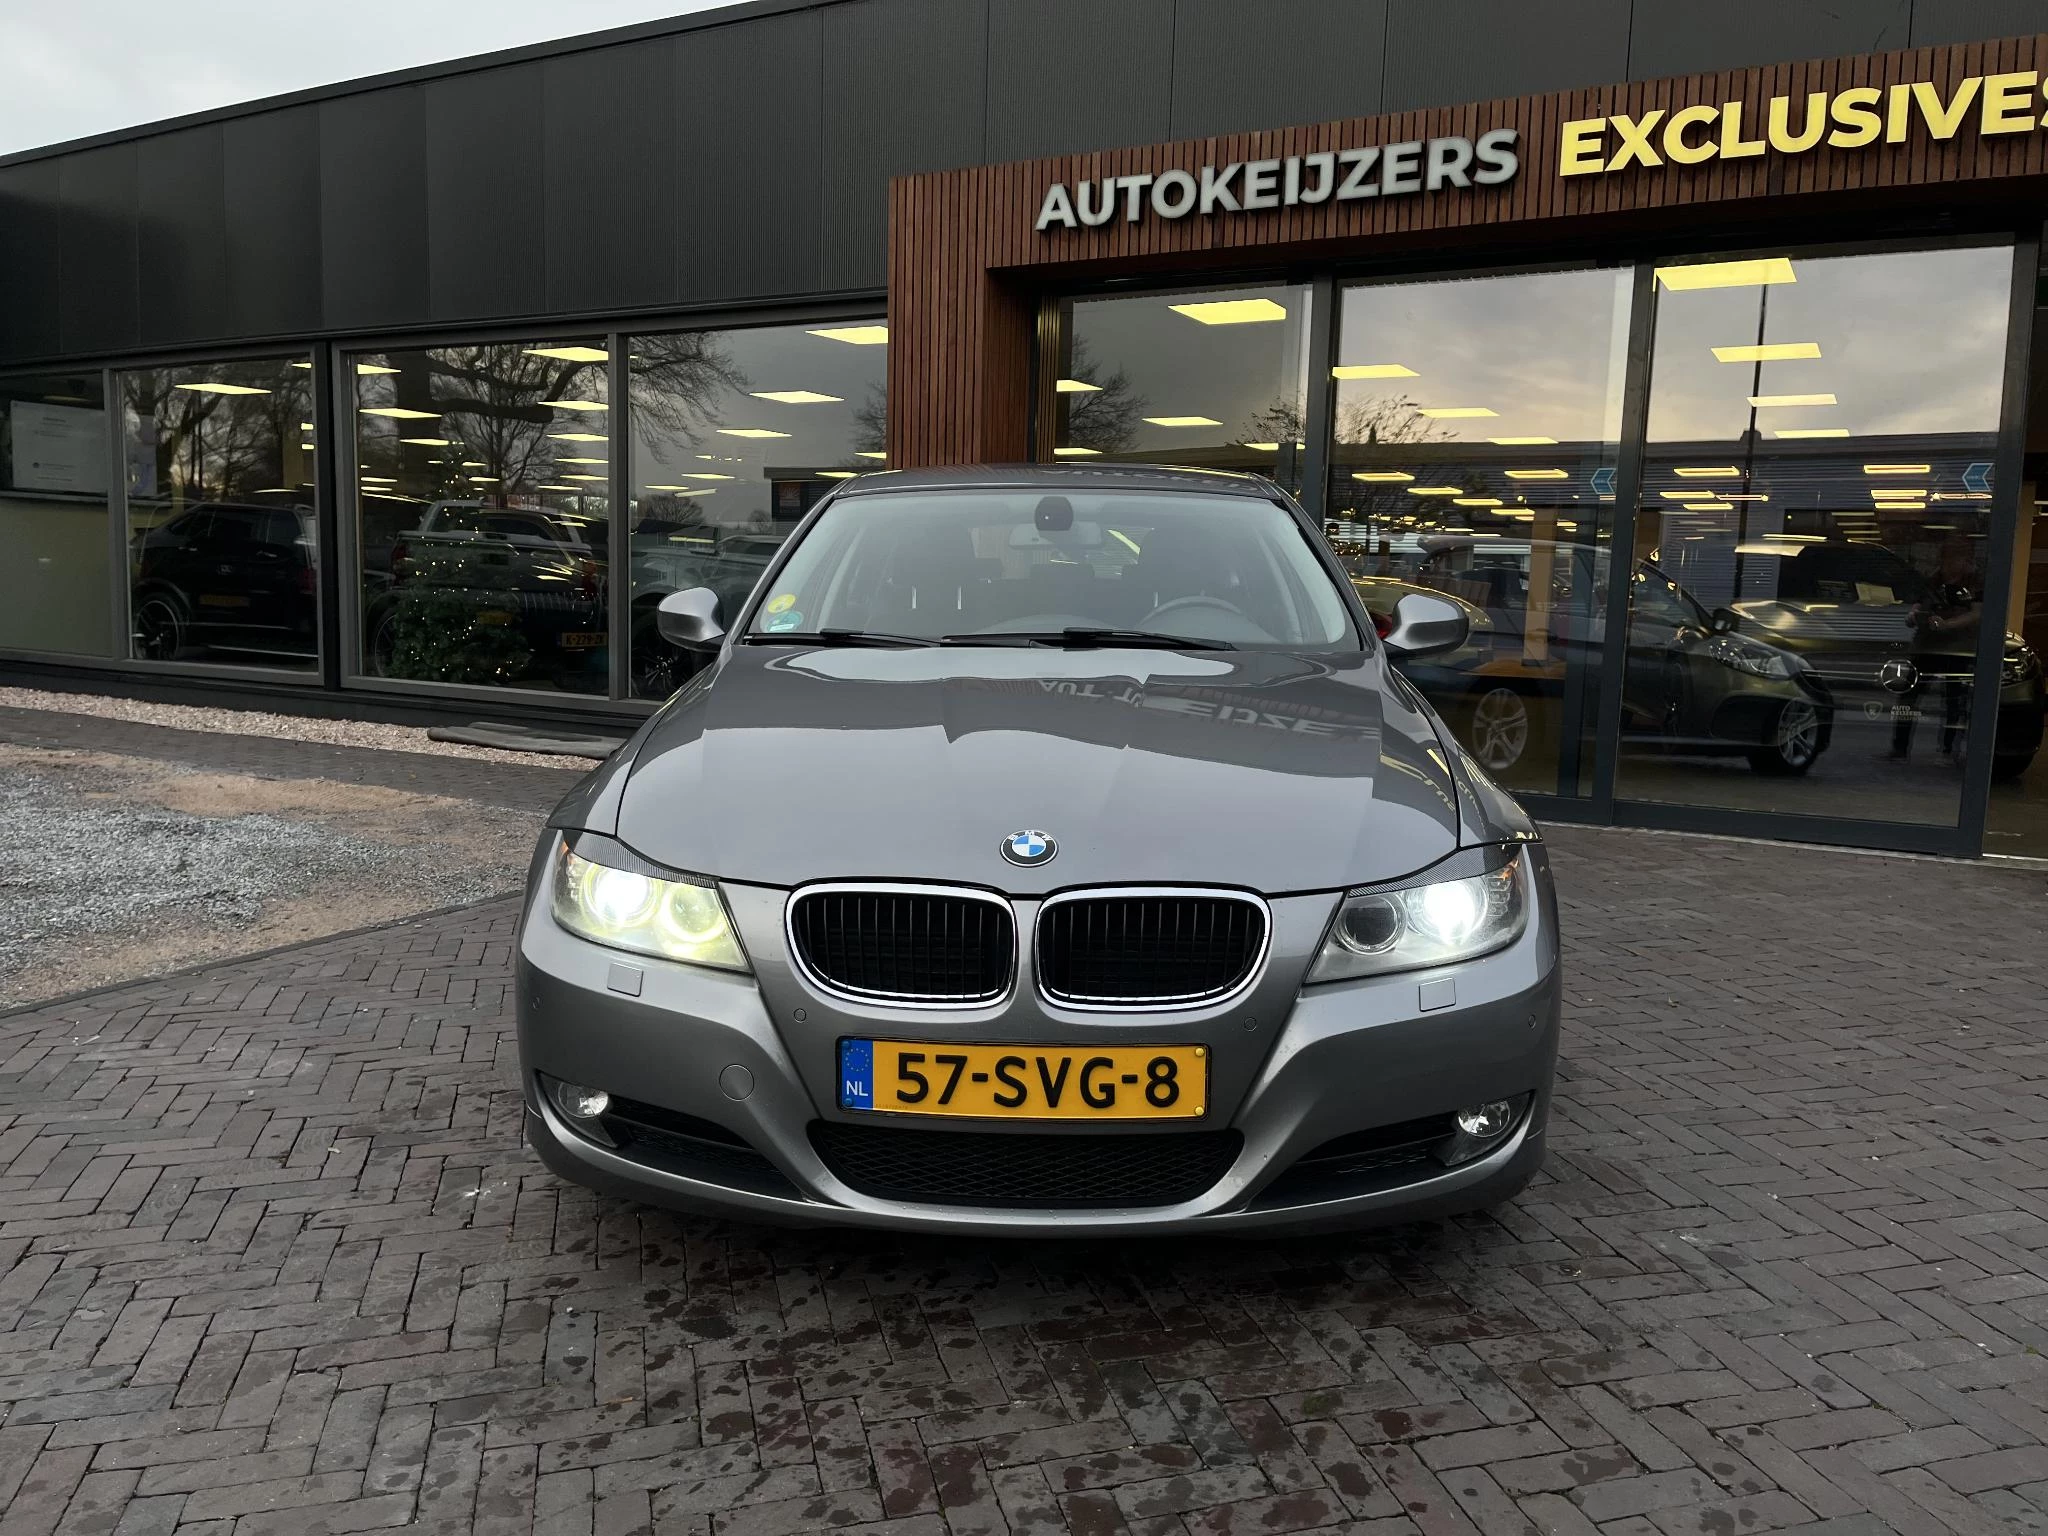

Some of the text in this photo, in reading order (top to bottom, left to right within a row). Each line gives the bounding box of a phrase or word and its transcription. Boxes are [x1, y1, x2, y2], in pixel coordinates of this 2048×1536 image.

[1035, 70, 2048, 231] AUTOKEIJZERS EXCLUSIVE
[846, 1080, 868, 1097] NL
[896, 1052, 1180, 1109] 57-SVG-8
